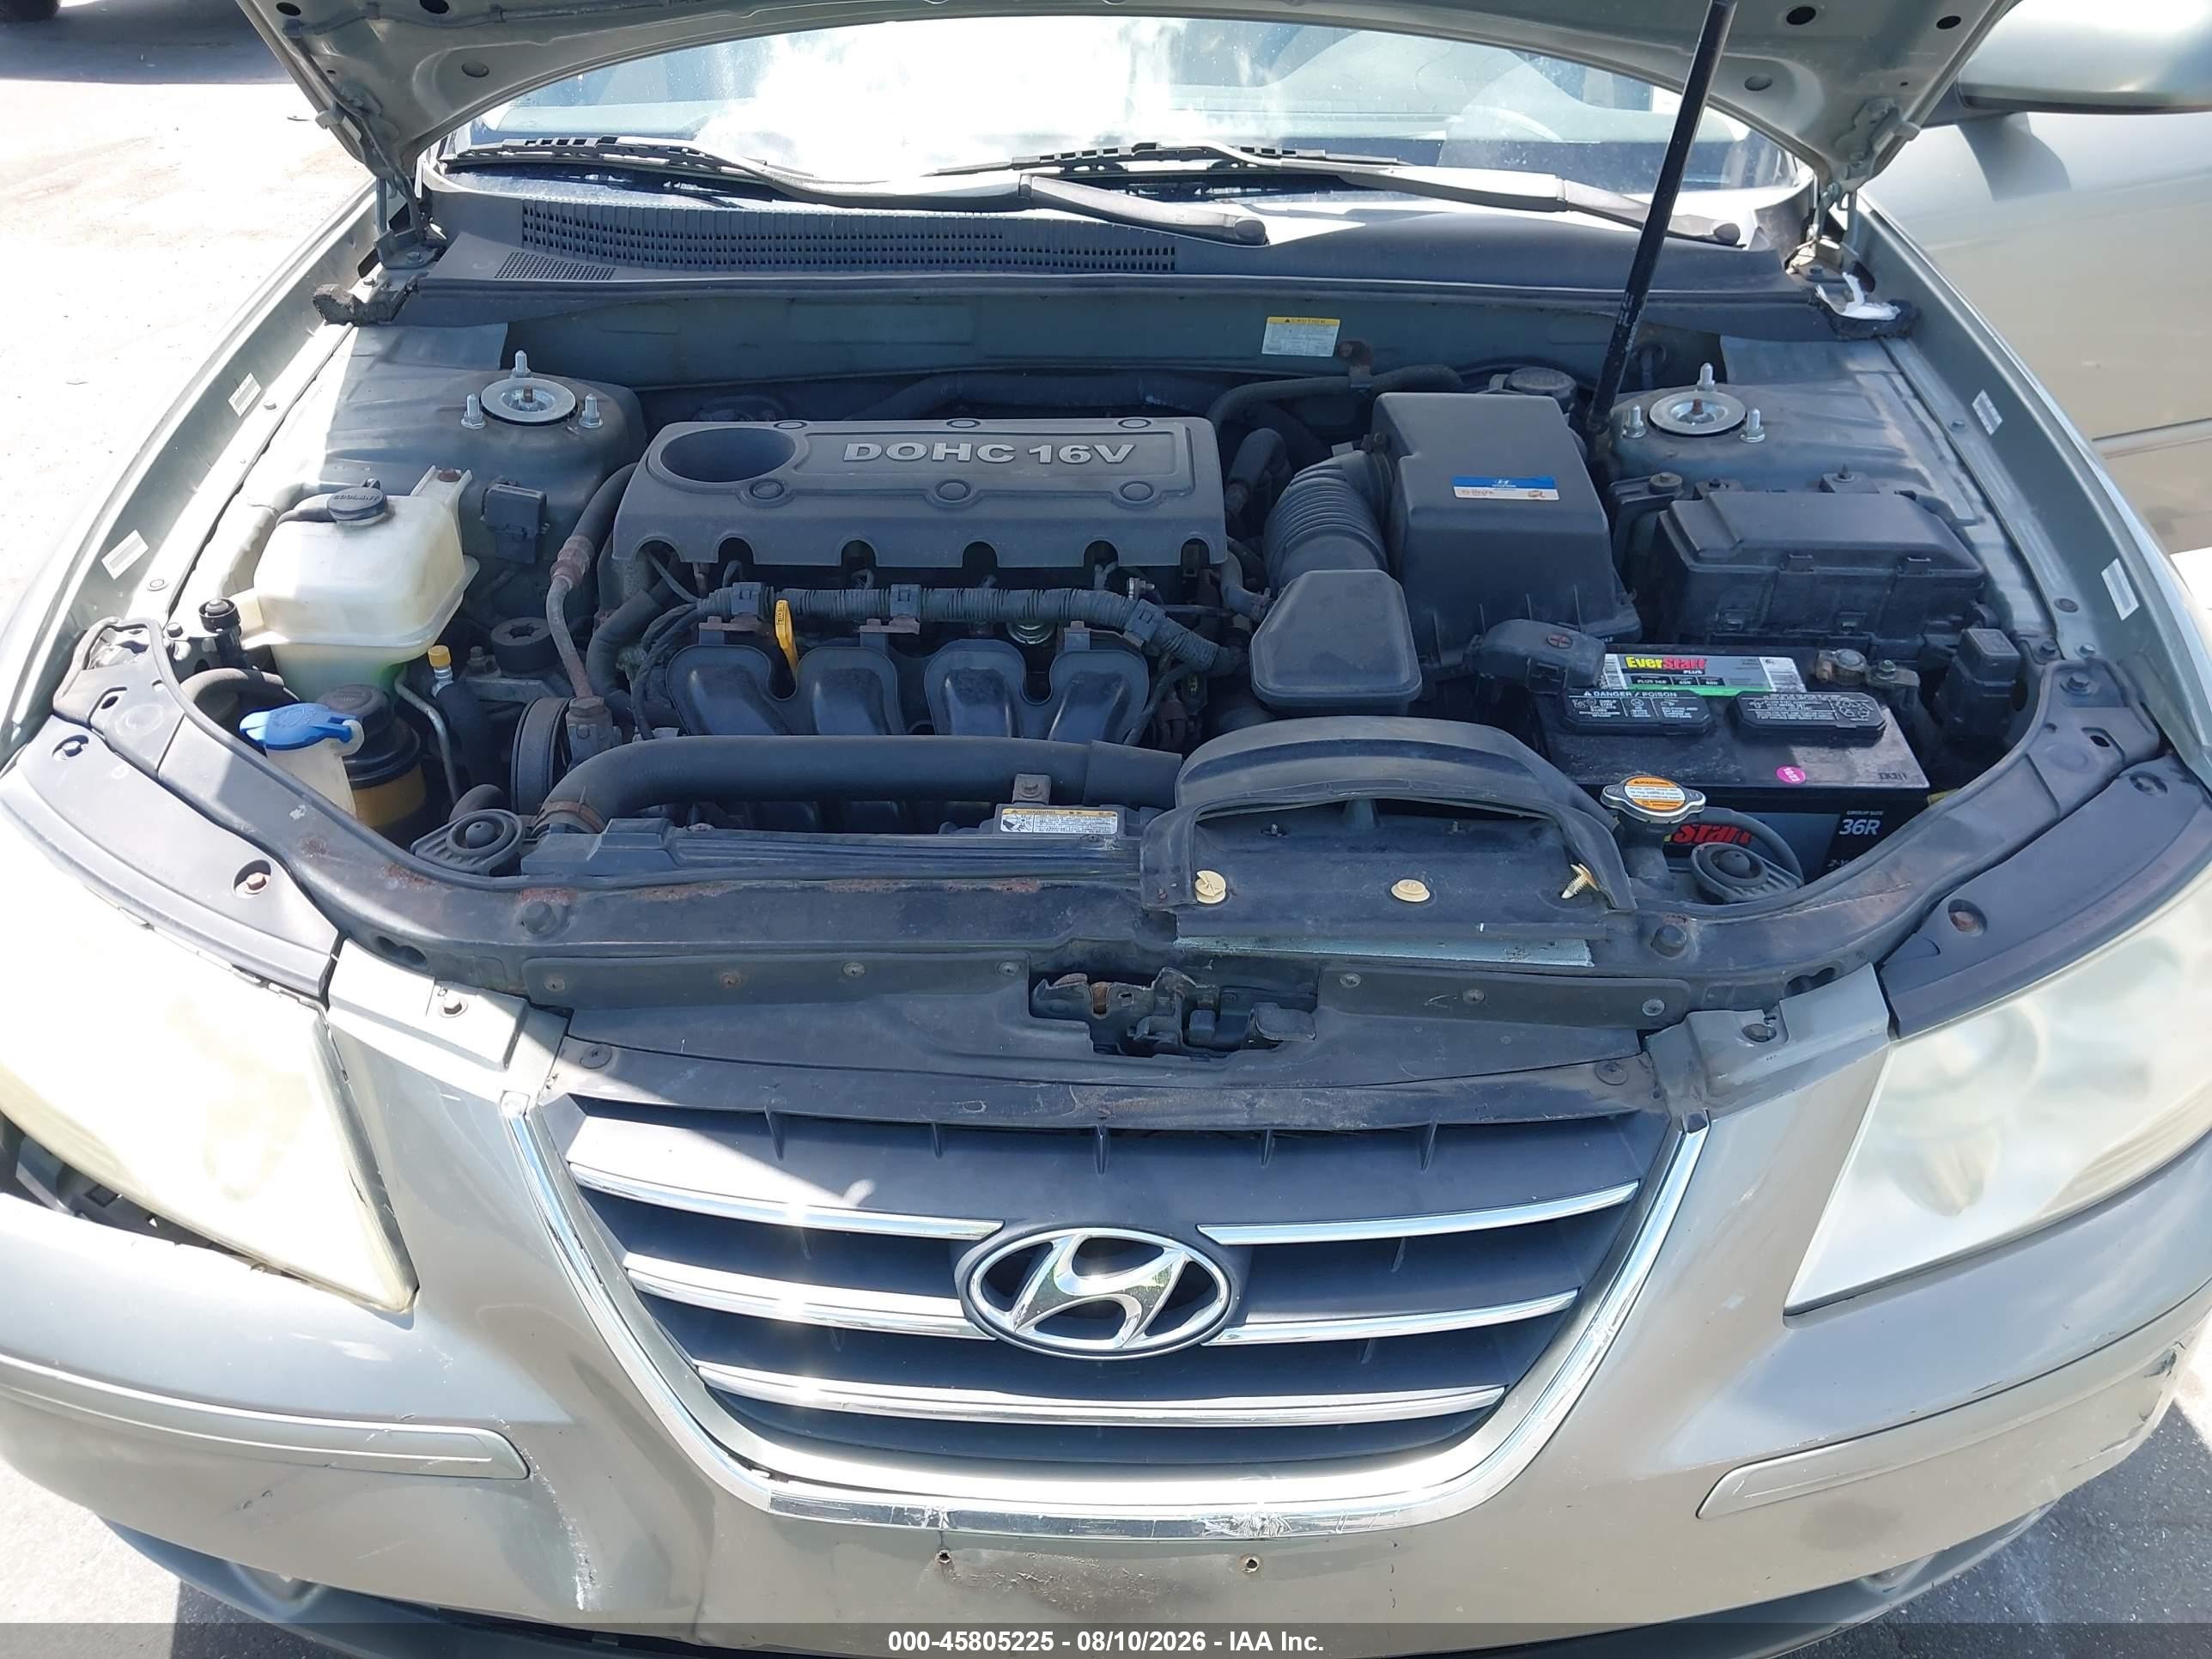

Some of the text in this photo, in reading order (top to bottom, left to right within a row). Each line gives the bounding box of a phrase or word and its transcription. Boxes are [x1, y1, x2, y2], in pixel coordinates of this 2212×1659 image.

[843, 441, 1136, 464] DOHC 16V
[1625, 656, 1707, 670] EverStart
[1838, 818, 1881, 836] 36R
